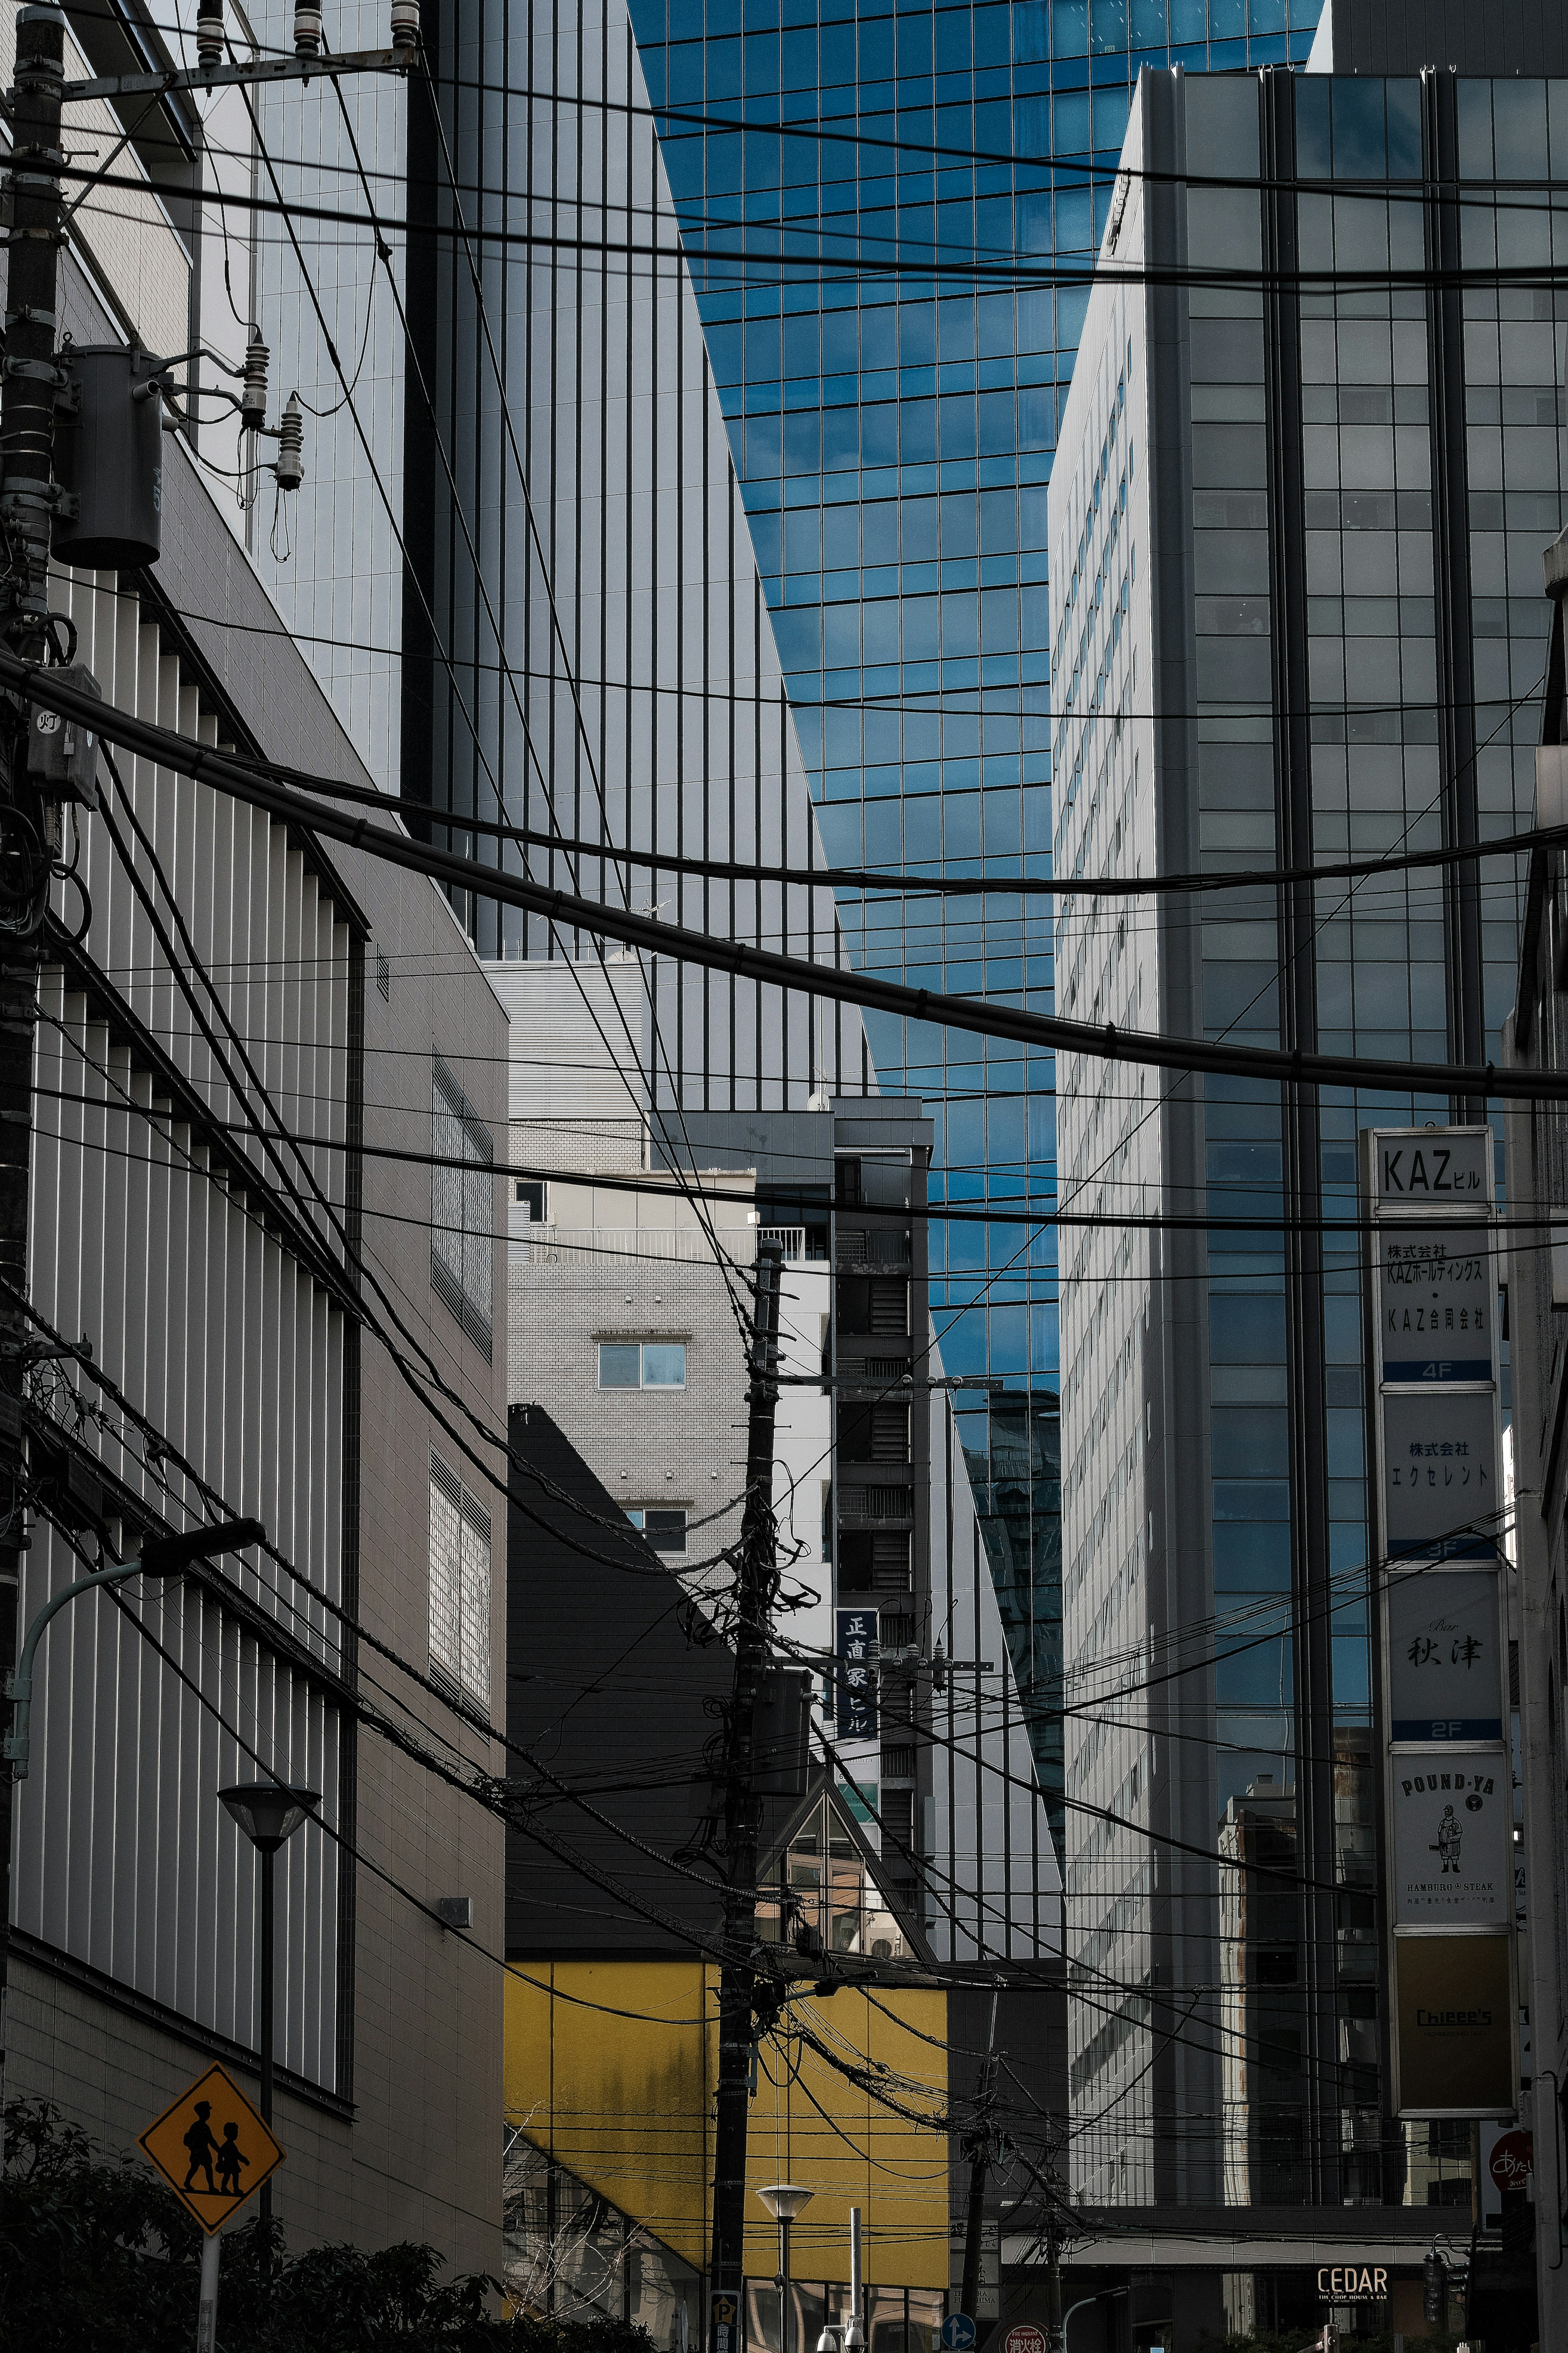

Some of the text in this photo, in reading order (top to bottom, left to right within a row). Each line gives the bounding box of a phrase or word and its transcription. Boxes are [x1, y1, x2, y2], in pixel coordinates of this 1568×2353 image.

[40, 714, 57, 730] 灯
[1387, 1244, 1447, 1259] 株式会社
[1387, 1260, 1482, 1284] KAZホールディングス
[1422, 1362, 1452, 1378] 4F
[1409, 1441, 1470, 1457] 株式会社
[1392, 1463, 1488, 1487] エクセレント
[1427, 1541, 1457, 1557] 3F
[1428, 1619, 1460, 1632] Bar
[1405, 1635, 1483, 1670] 秋津
[845, 1616, 868, 1733] 正直家ビル
[1432, 1722, 1462, 1738] 2F
[1417, 2008, 1492, 2027] Chieee's
[1317, 2267, 1388, 2293] CEDAR
[719, 2304, 731, 2320] P
[1009, 2338, 1042, 2353] 消火栓
